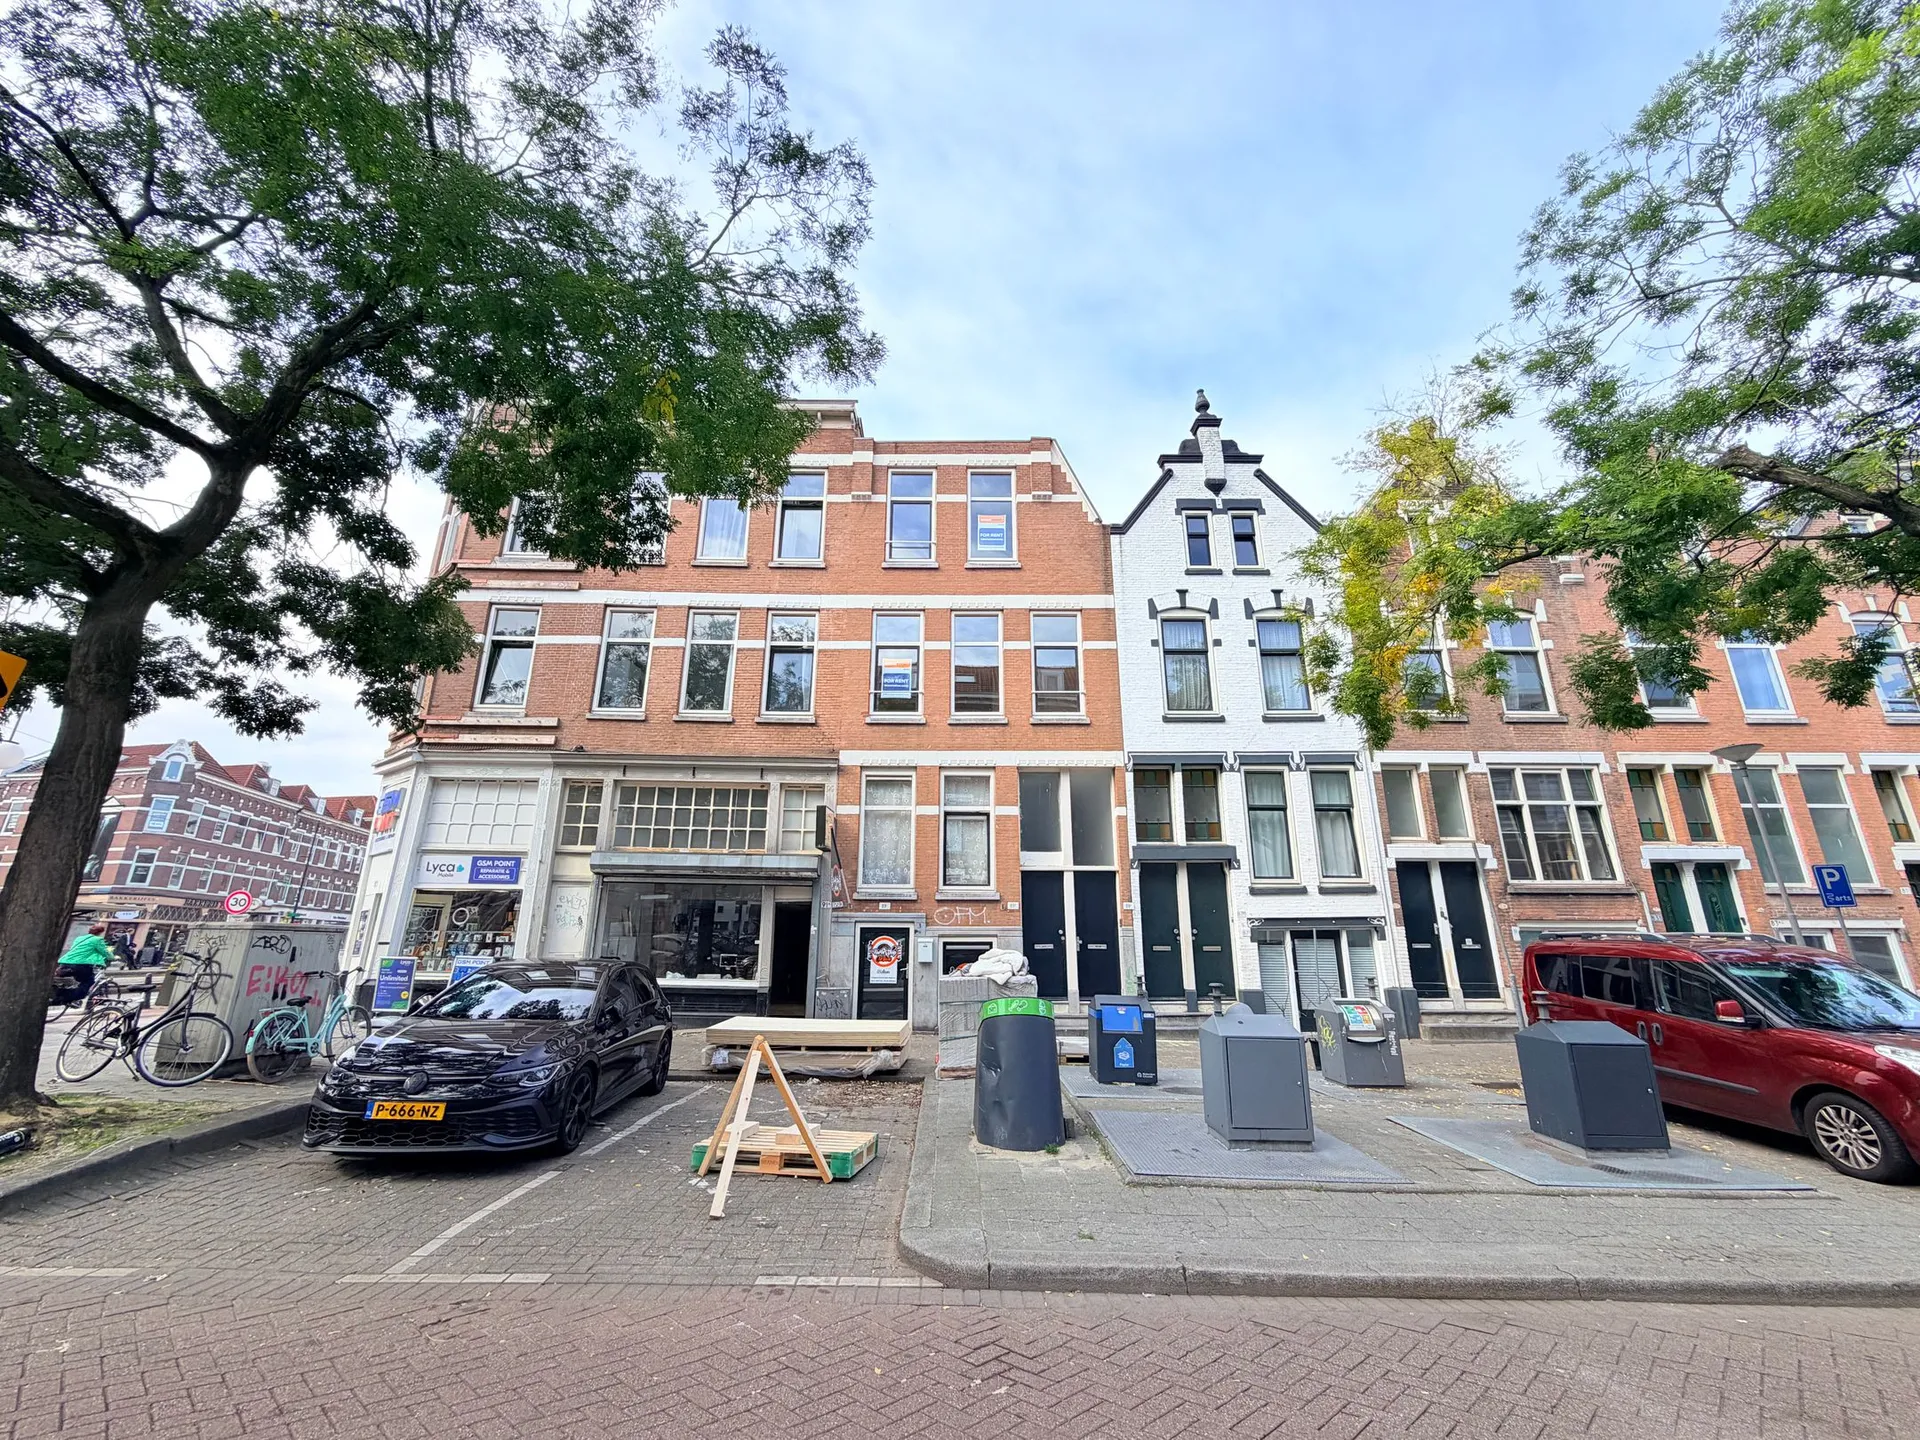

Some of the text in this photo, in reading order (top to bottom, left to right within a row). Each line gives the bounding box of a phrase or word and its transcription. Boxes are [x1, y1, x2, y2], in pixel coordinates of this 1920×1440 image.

[426, 861, 456, 875] Lyca
[476, 859, 516, 867] GSM POINT
[1821, 868, 1841, 890] P
[230, 897, 247, 908] 30
[1835, 893, 1852, 902] arts
[380, 974, 409, 982] Unlimited
[375, 1104, 440, 1118] P-666-NZ
